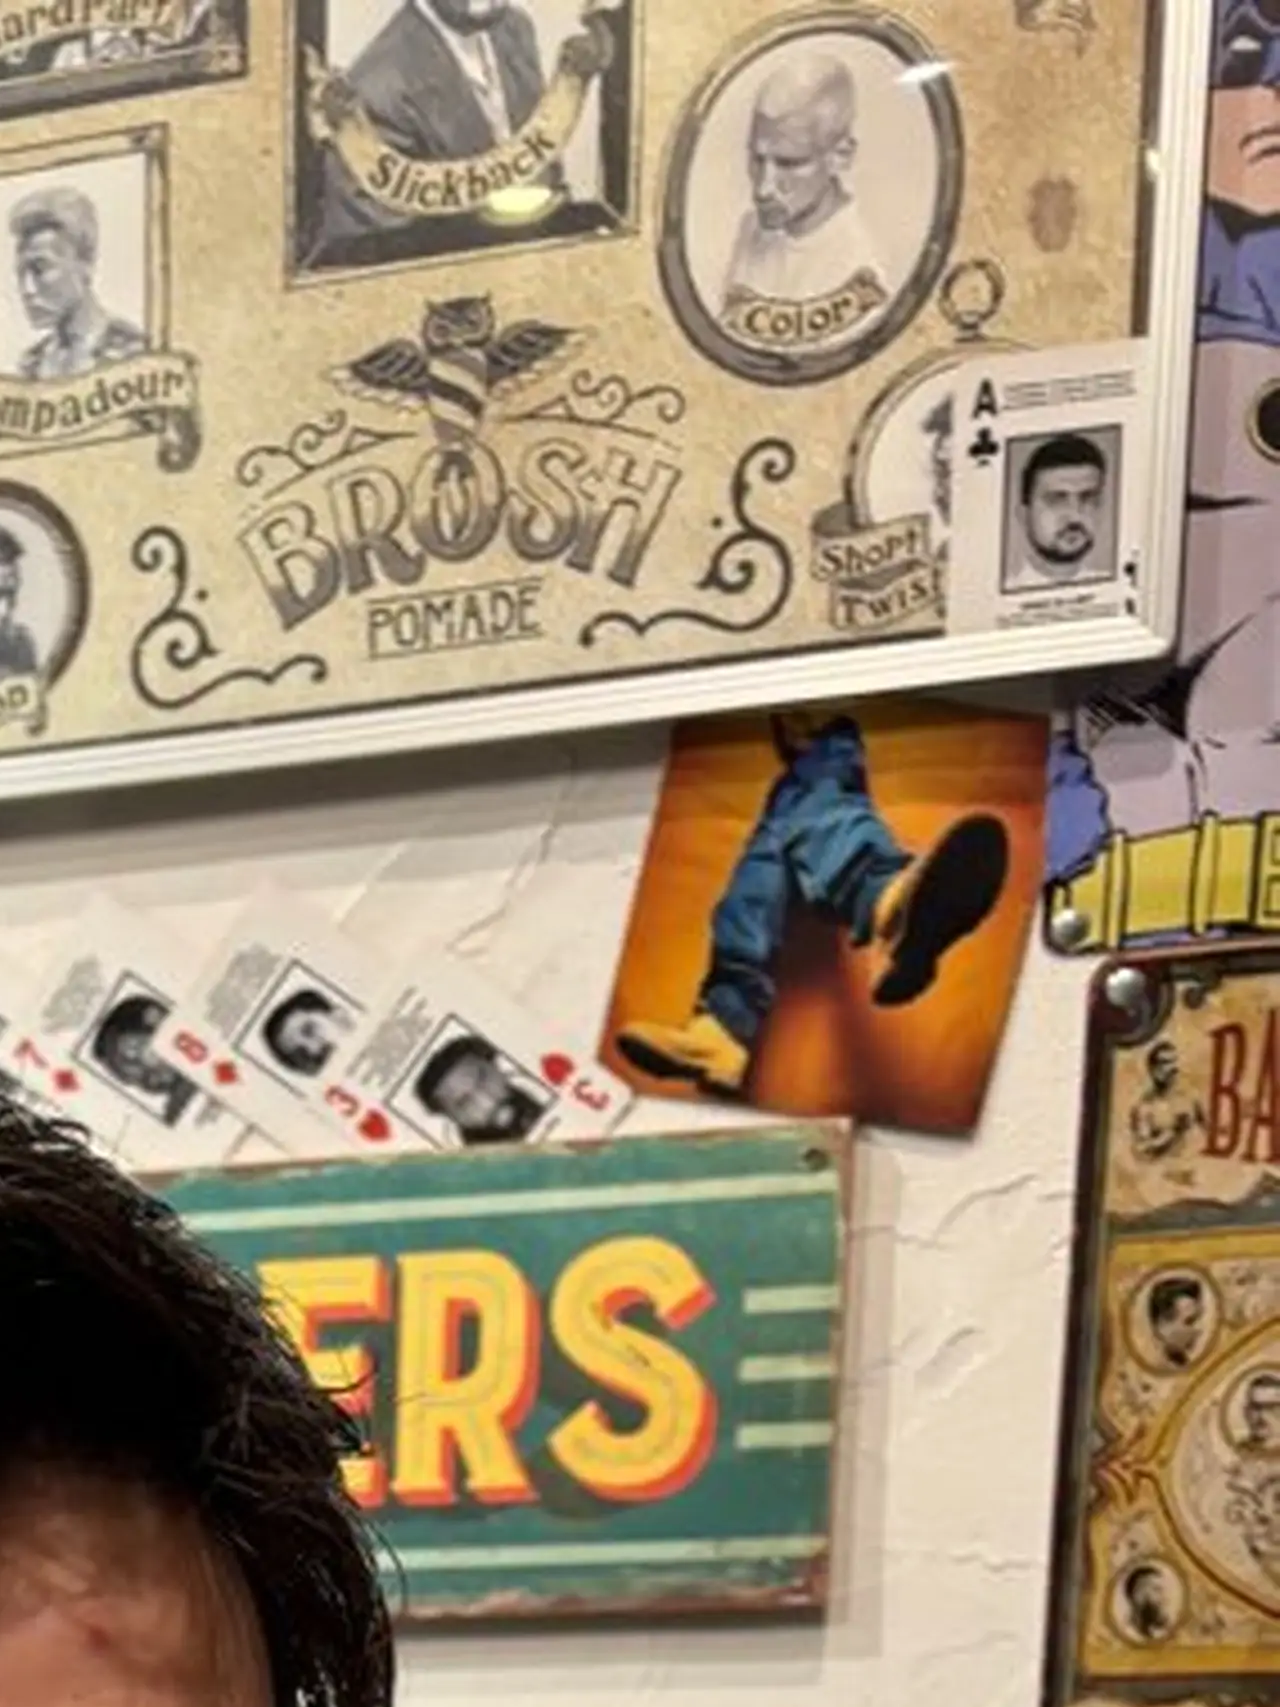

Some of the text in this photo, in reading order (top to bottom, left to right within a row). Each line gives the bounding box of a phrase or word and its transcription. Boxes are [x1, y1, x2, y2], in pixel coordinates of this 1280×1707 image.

[745, 297, 852, 337] Color
[972, 379, 997, 418] A
[239, 437, 682, 632] BROSH
[812, 528, 916, 582] Short
[368, 585, 540, 652] POMADE
